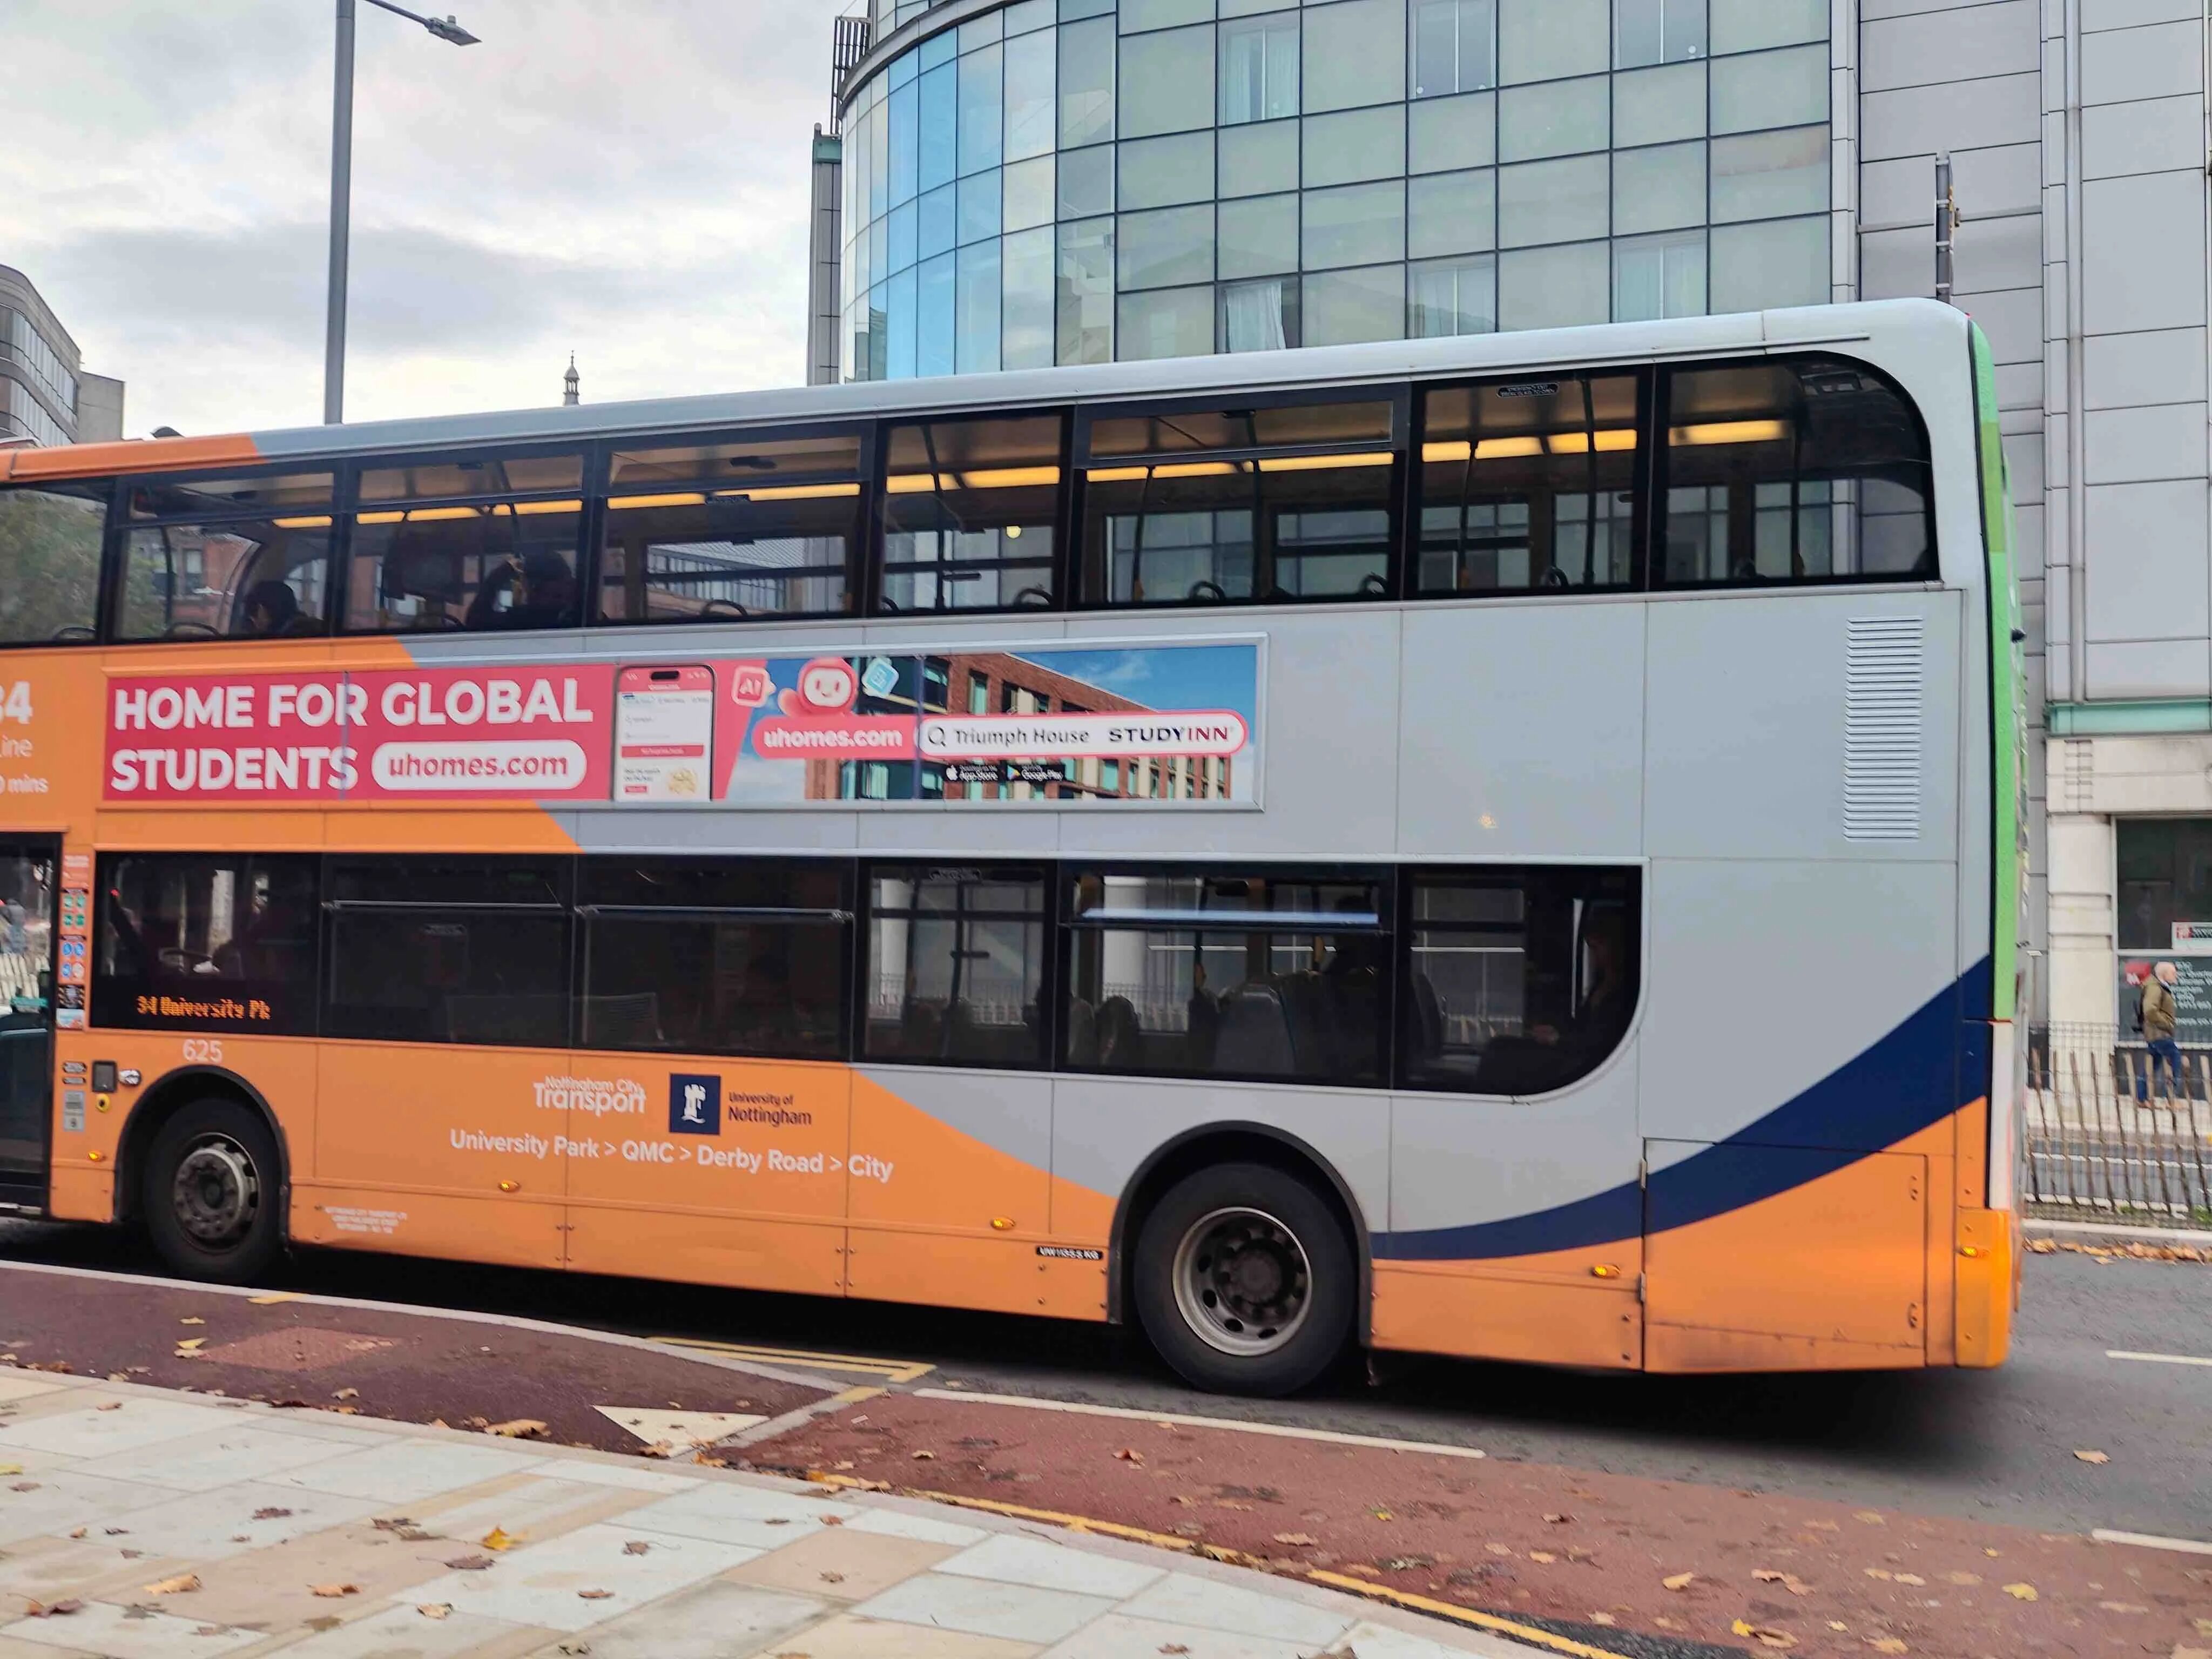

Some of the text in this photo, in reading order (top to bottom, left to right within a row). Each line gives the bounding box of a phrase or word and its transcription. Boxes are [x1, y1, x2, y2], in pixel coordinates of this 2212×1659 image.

[0, 681, 33, 725] 4
[114, 678, 593, 730] HOME FOR GLOBAL
[0, 734, 32, 757] ine
[764, 727, 902, 748] uhomes.com
[956, 727, 1027, 747] Triumph
[1033, 728, 1089, 744] House
[111, 746, 568, 791] STUDENTS uhomes.com
[8, 773, 48, 794] mins
[137, 996, 271, 1020] 34 University Pk
[182, 1038, 223, 1063] 625
[544, 1075, 646, 1097] Nottingham City
[533, 1082, 647, 1118] Transport
[729, 1091, 793, 1106] University of
[729, 1106, 812, 1128] Nottingham
[450, 1129, 549, 1159] University
[554, 1135, 599, 1158] Park
[622, 1140, 675, 1163] QMC
[697, 1144, 763, 1174] Derby
[768, 1149, 824, 1174] Road
[848, 1154, 894, 1183] City
